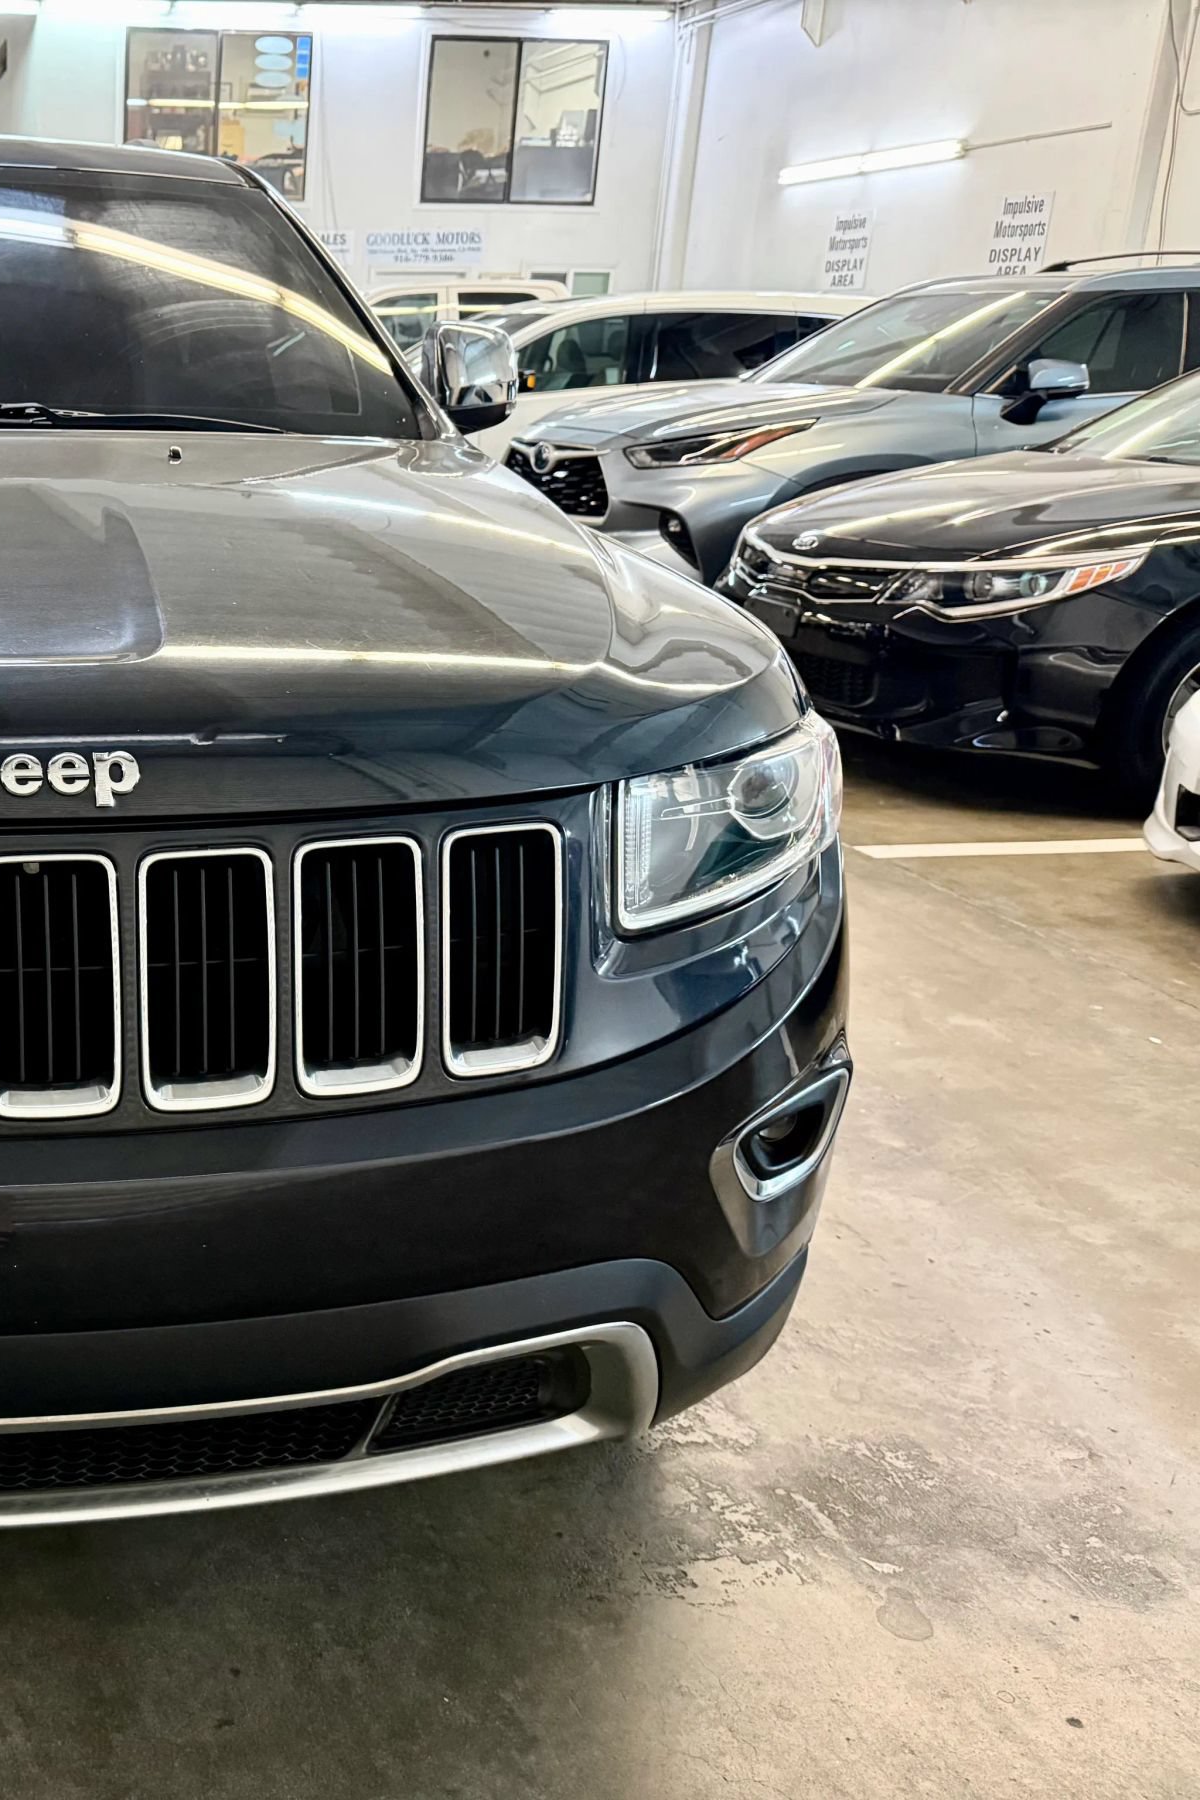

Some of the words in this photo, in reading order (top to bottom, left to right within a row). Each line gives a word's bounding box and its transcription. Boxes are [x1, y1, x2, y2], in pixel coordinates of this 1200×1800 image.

[1003, 194, 1045, 219] Impulsive
[835, 213, 867, 235] Impulsive
[993, 220, 1047, 242] Motorsports
[366, 232, 430, 246] GOODLUCK
[436, 231, 482, 245] MOTORS
[829, 236, 868, 254] Motorsports
[988, 246, 1041, 264] DISPLAY
[825, 258, 864, 273] DISPLAY
[830, 273, 854, 287] AREA
